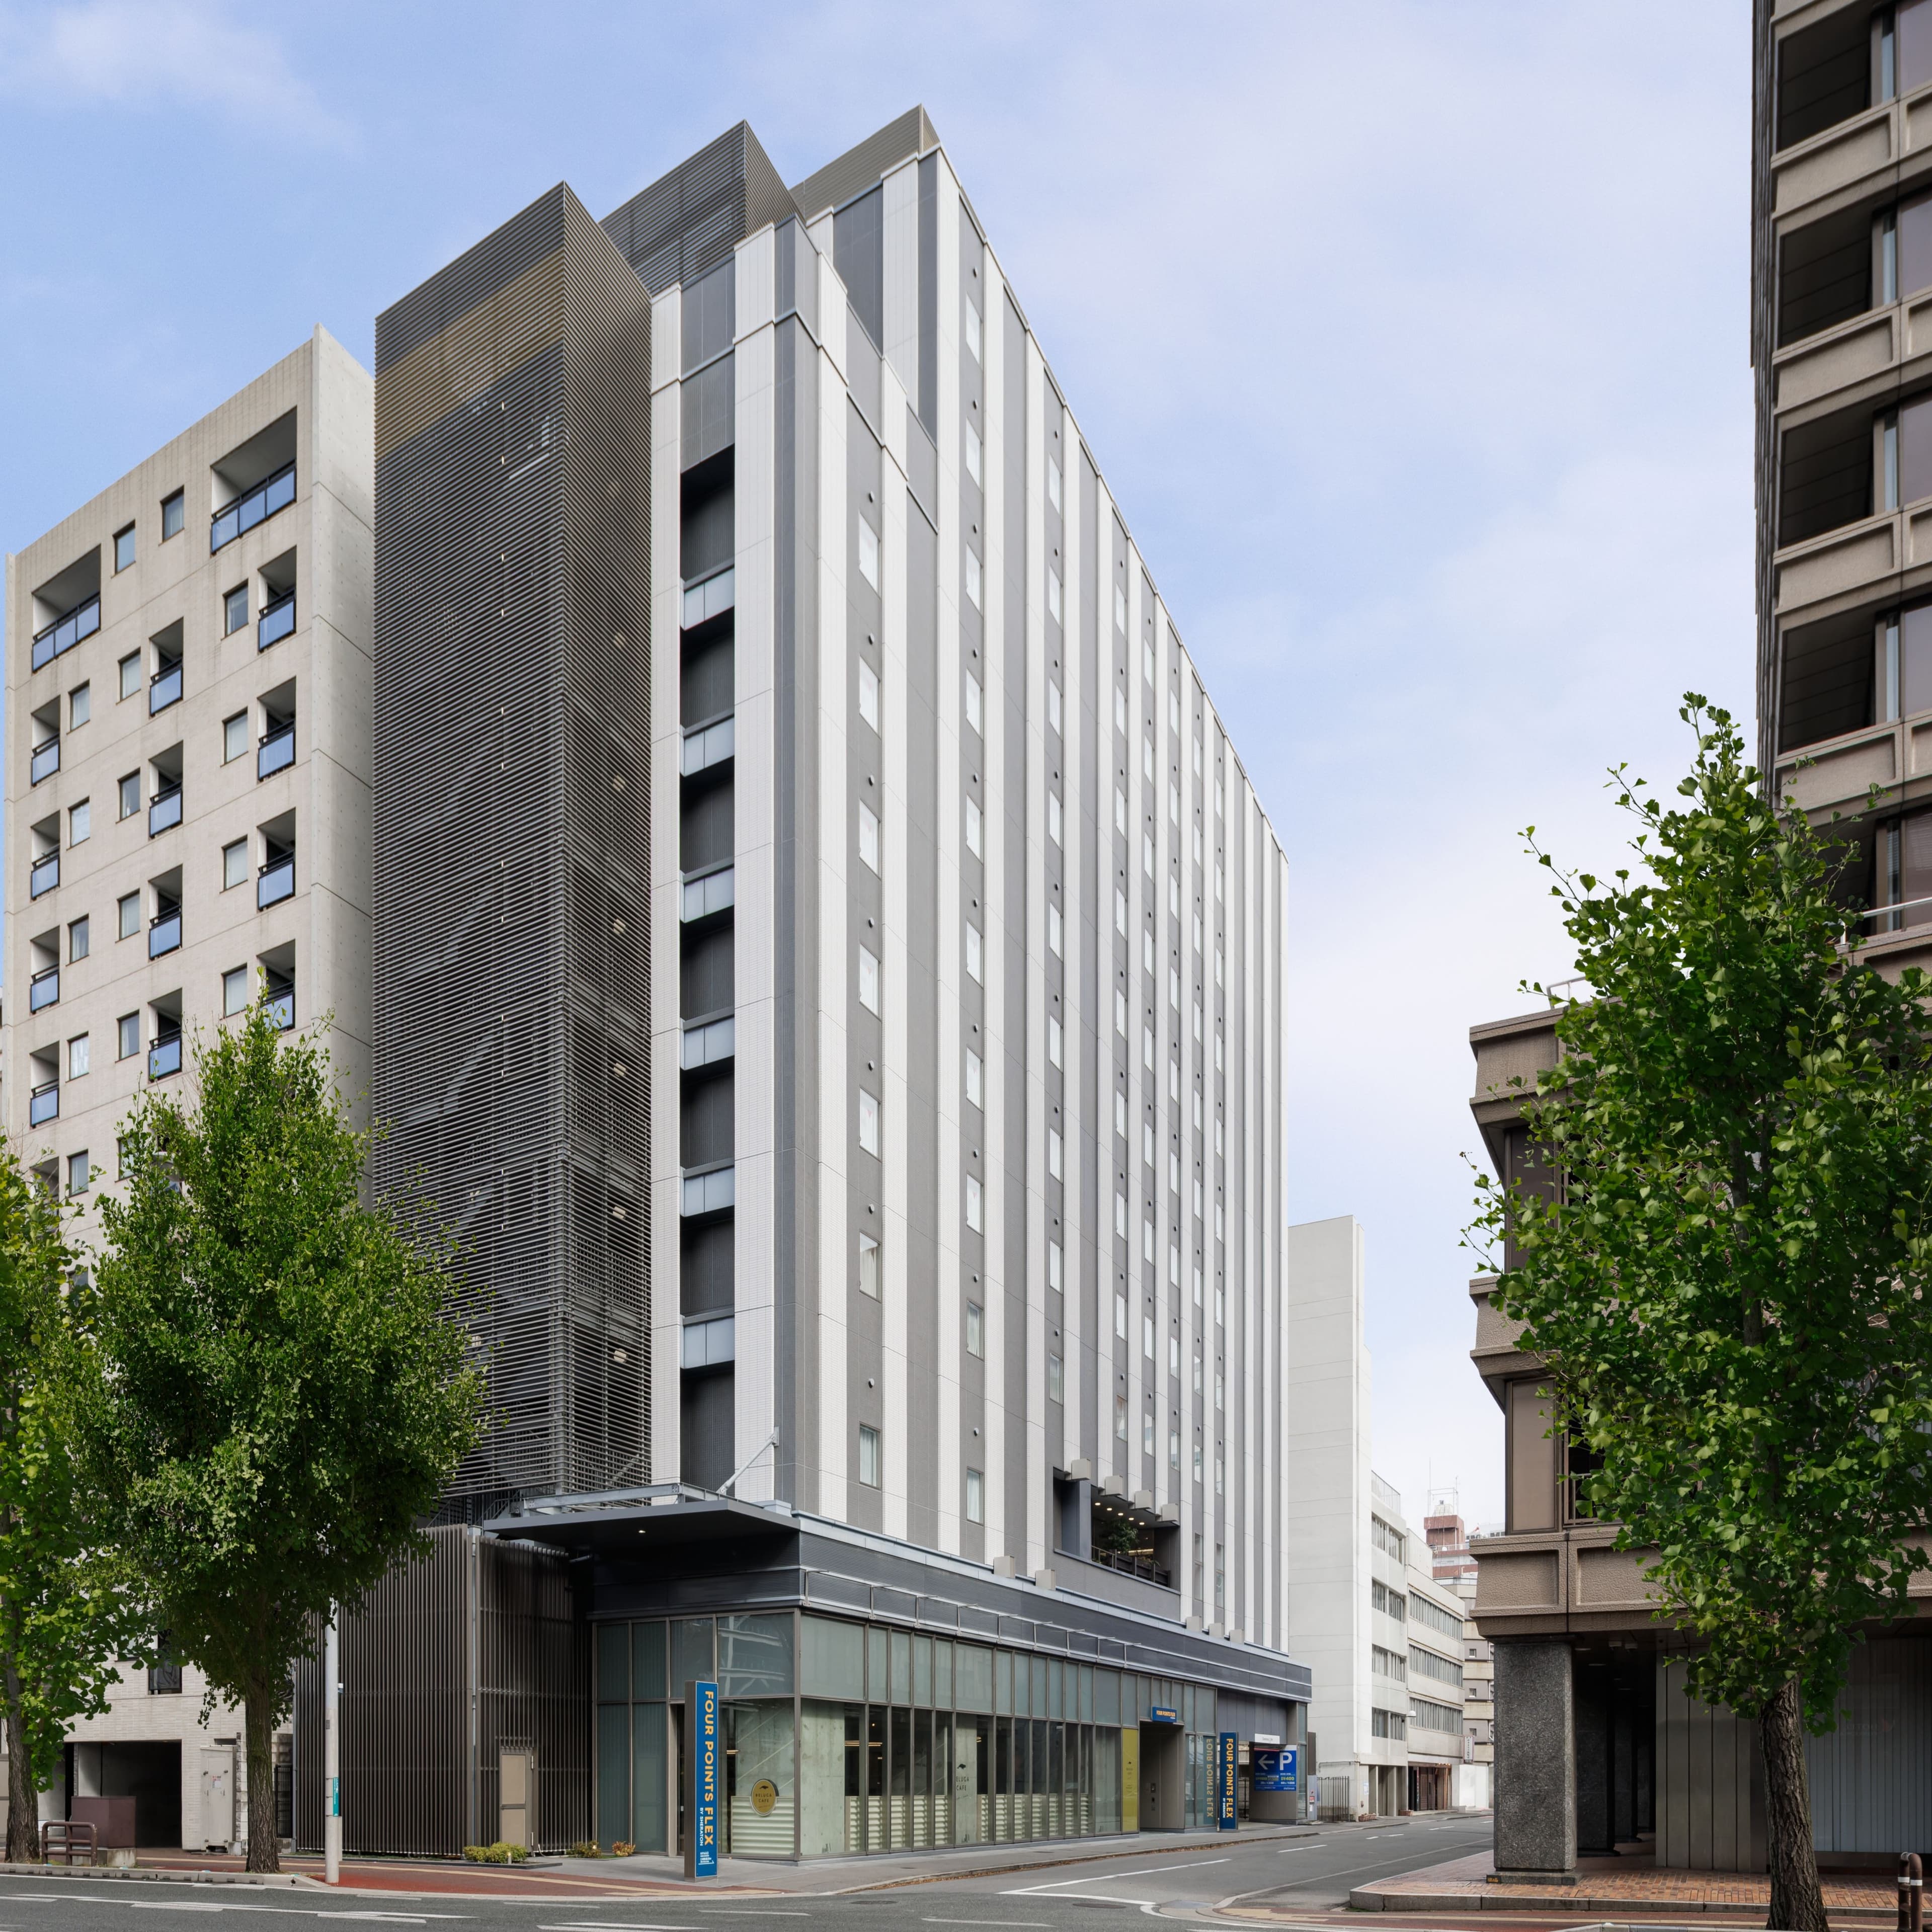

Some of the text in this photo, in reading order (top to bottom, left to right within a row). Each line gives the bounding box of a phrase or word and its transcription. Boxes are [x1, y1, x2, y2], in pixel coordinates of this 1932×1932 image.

[705, 1691, 713, 1735] FOUR
[705, 1741, 713, 1801] POINTS
[1280, 1752, 1293, 1770] P
[705, 1807, 713, 1845] FLEX
